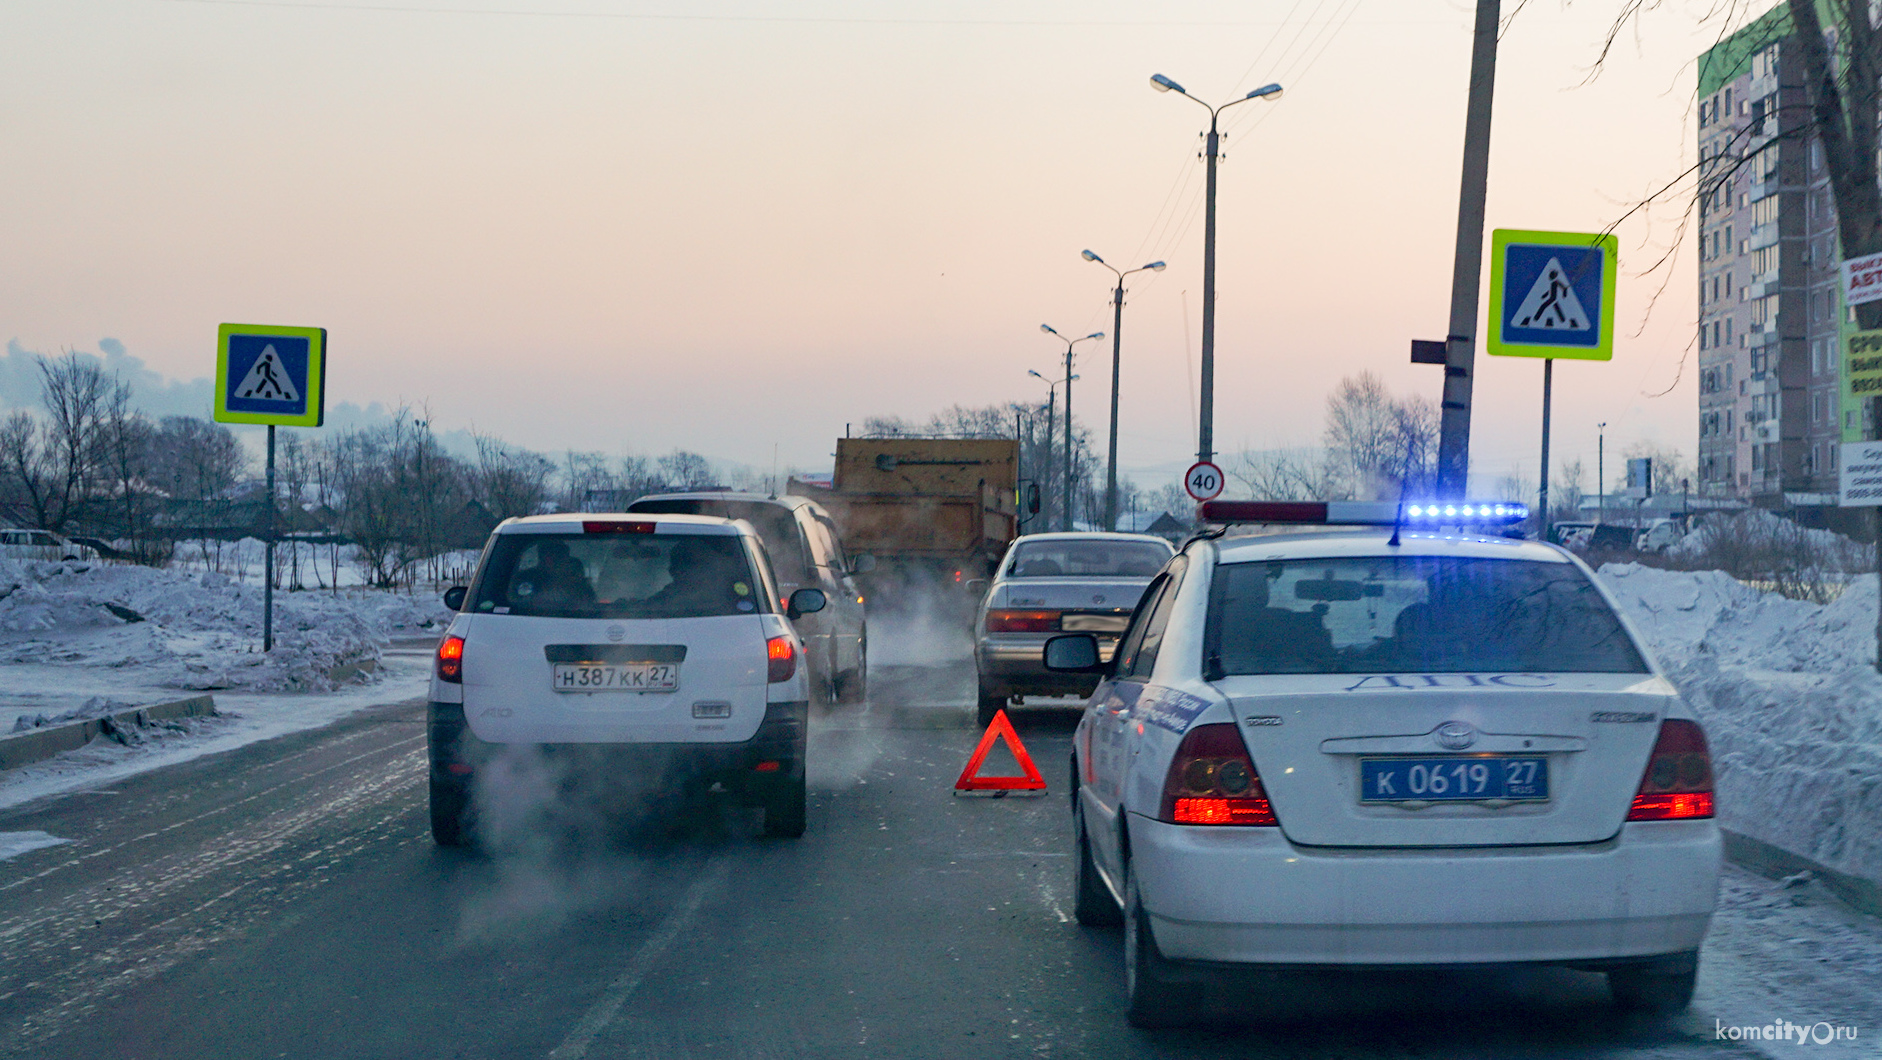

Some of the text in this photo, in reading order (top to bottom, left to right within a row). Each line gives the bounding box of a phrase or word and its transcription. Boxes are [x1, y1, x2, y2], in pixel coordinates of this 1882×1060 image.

[1192, 474, 1215, 490] 40
[650, 666, 669, 680] 27
[1344, 674, 1557, 691] ДПС
[1507, 761, 1538, 784] 27
